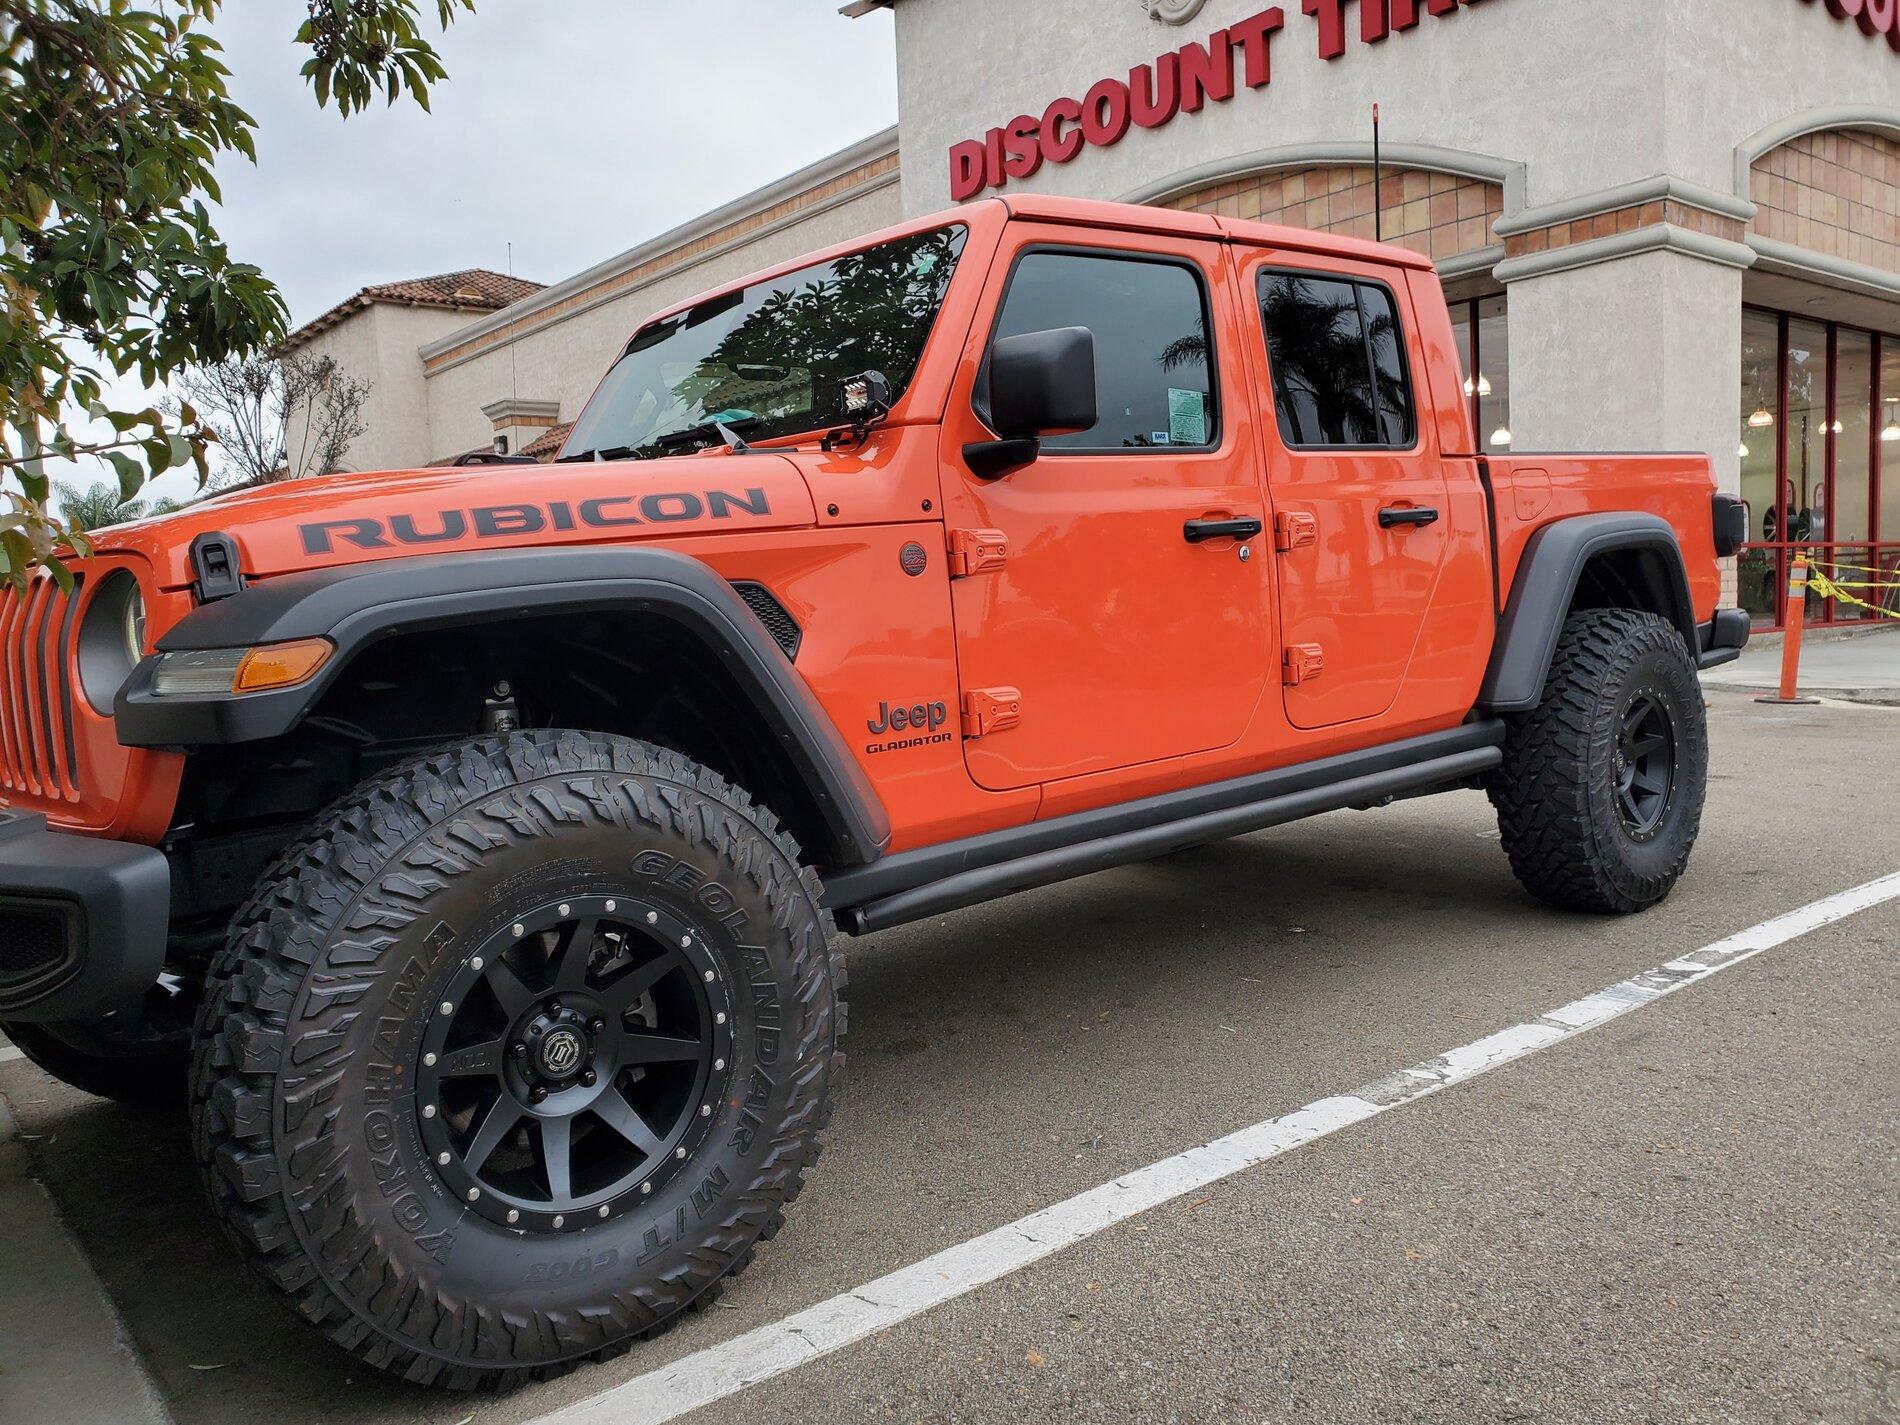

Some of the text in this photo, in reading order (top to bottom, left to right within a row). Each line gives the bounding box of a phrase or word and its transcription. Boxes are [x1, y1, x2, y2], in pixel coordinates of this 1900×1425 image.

[949, 6, 1284, 200] DISCOUNT
[297, 487, 773, 556] RUBICON
[865, 732, 953, 755] GLADIATOR
[867, 700, 947, 734] Jeep
[630, 848, 780, 1159] GEOLANDAR
[363, 920, 458, 1266] YOKOHAMA
